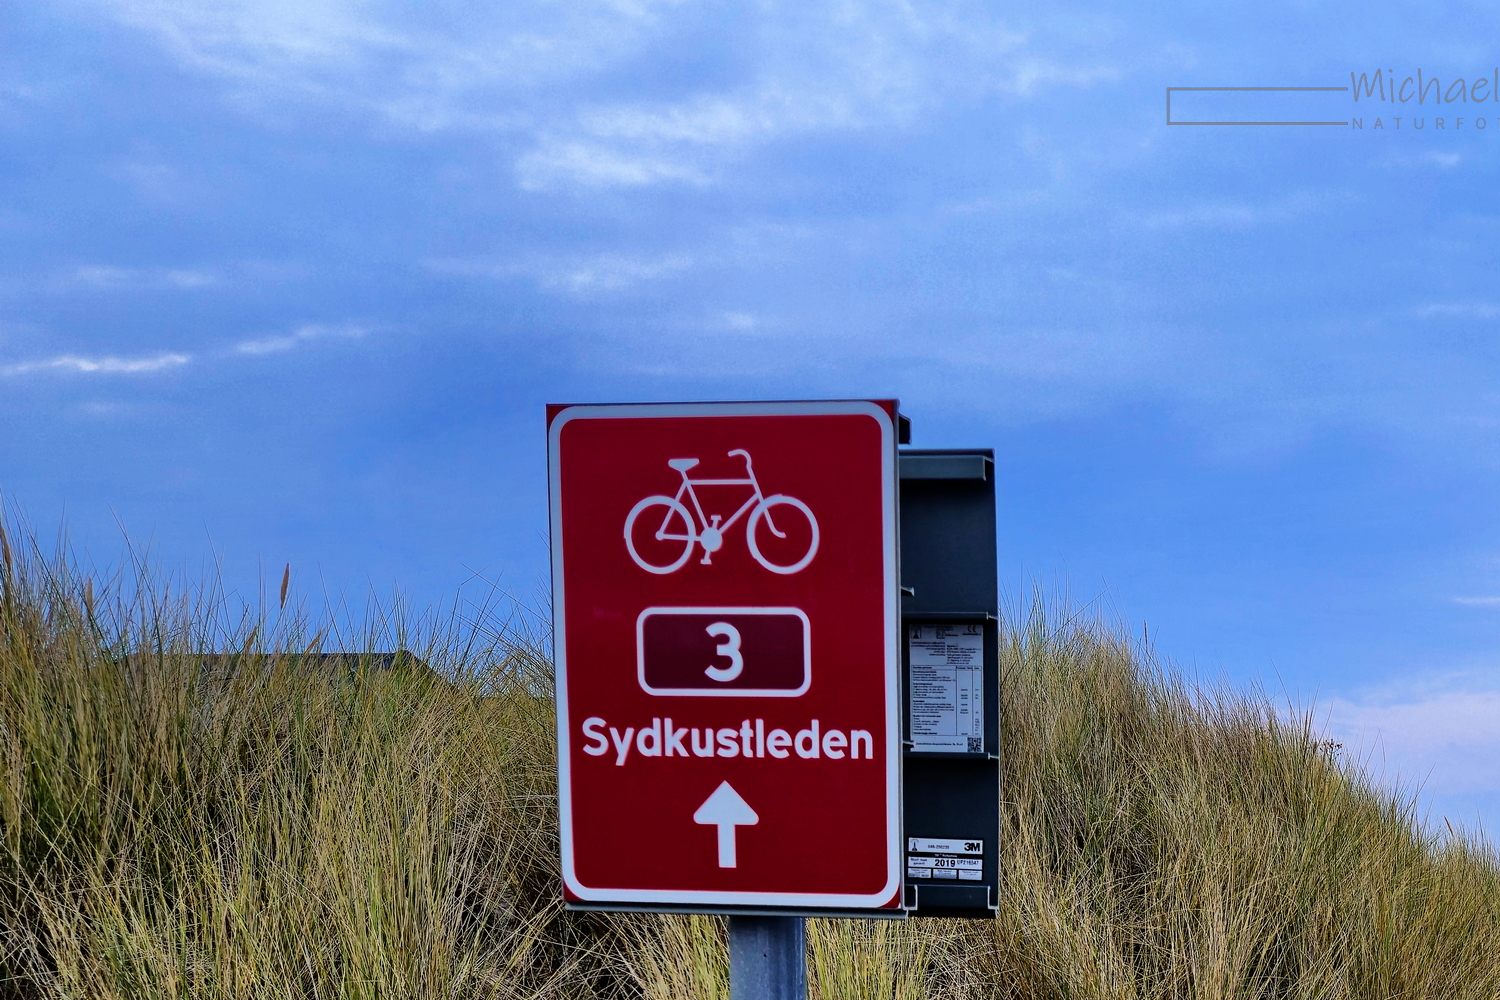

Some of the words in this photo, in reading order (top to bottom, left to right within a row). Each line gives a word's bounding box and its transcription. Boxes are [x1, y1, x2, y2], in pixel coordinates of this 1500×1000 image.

[704, 622, 744, 683] 3
[582, 717, 874, 766] Sydkustleden
[964, 842, 981, 852] 3M
[934, 859, 956, 867] 2019
